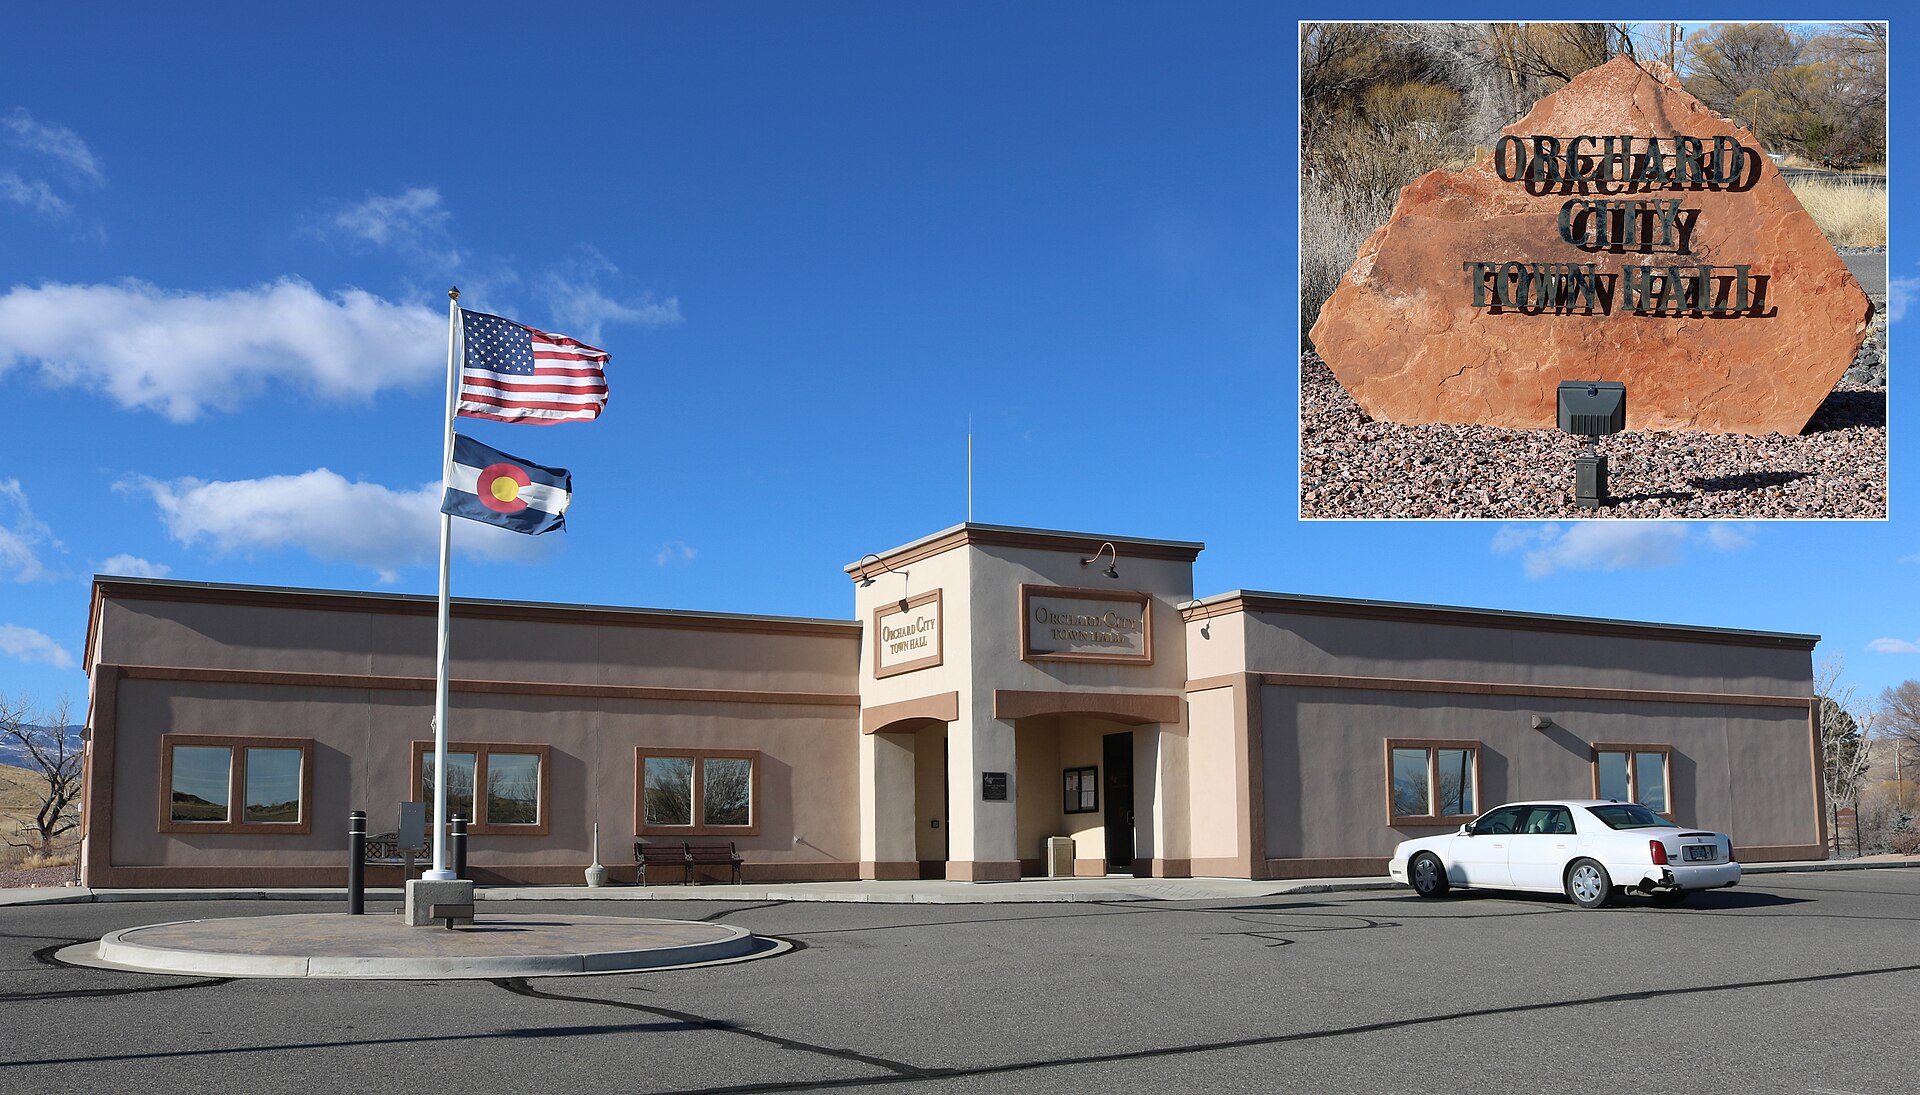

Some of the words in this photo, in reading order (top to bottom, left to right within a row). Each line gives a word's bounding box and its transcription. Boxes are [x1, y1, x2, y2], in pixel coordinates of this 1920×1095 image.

[1495, 135, 1744, 184] ORCHARD
[1557, 199, 1683, 247] CITY
[1463, 261, 1598, 309] TOWN
[1621, 264, 1765, 311] HALL
[882, 624, 916, 642] ORCHARD
[916, 616, 936, 633] CITY
[1035, 607, 1101, 627] ORCHARD
[1103, 609, 1137, 629] CITY
[890, 640, 909, 655] TOWN
[909, 636, 928, 650] HALL
[1050, 628, 1088, 641] TOWN
[1090, 631, 1125, 644] HALL
